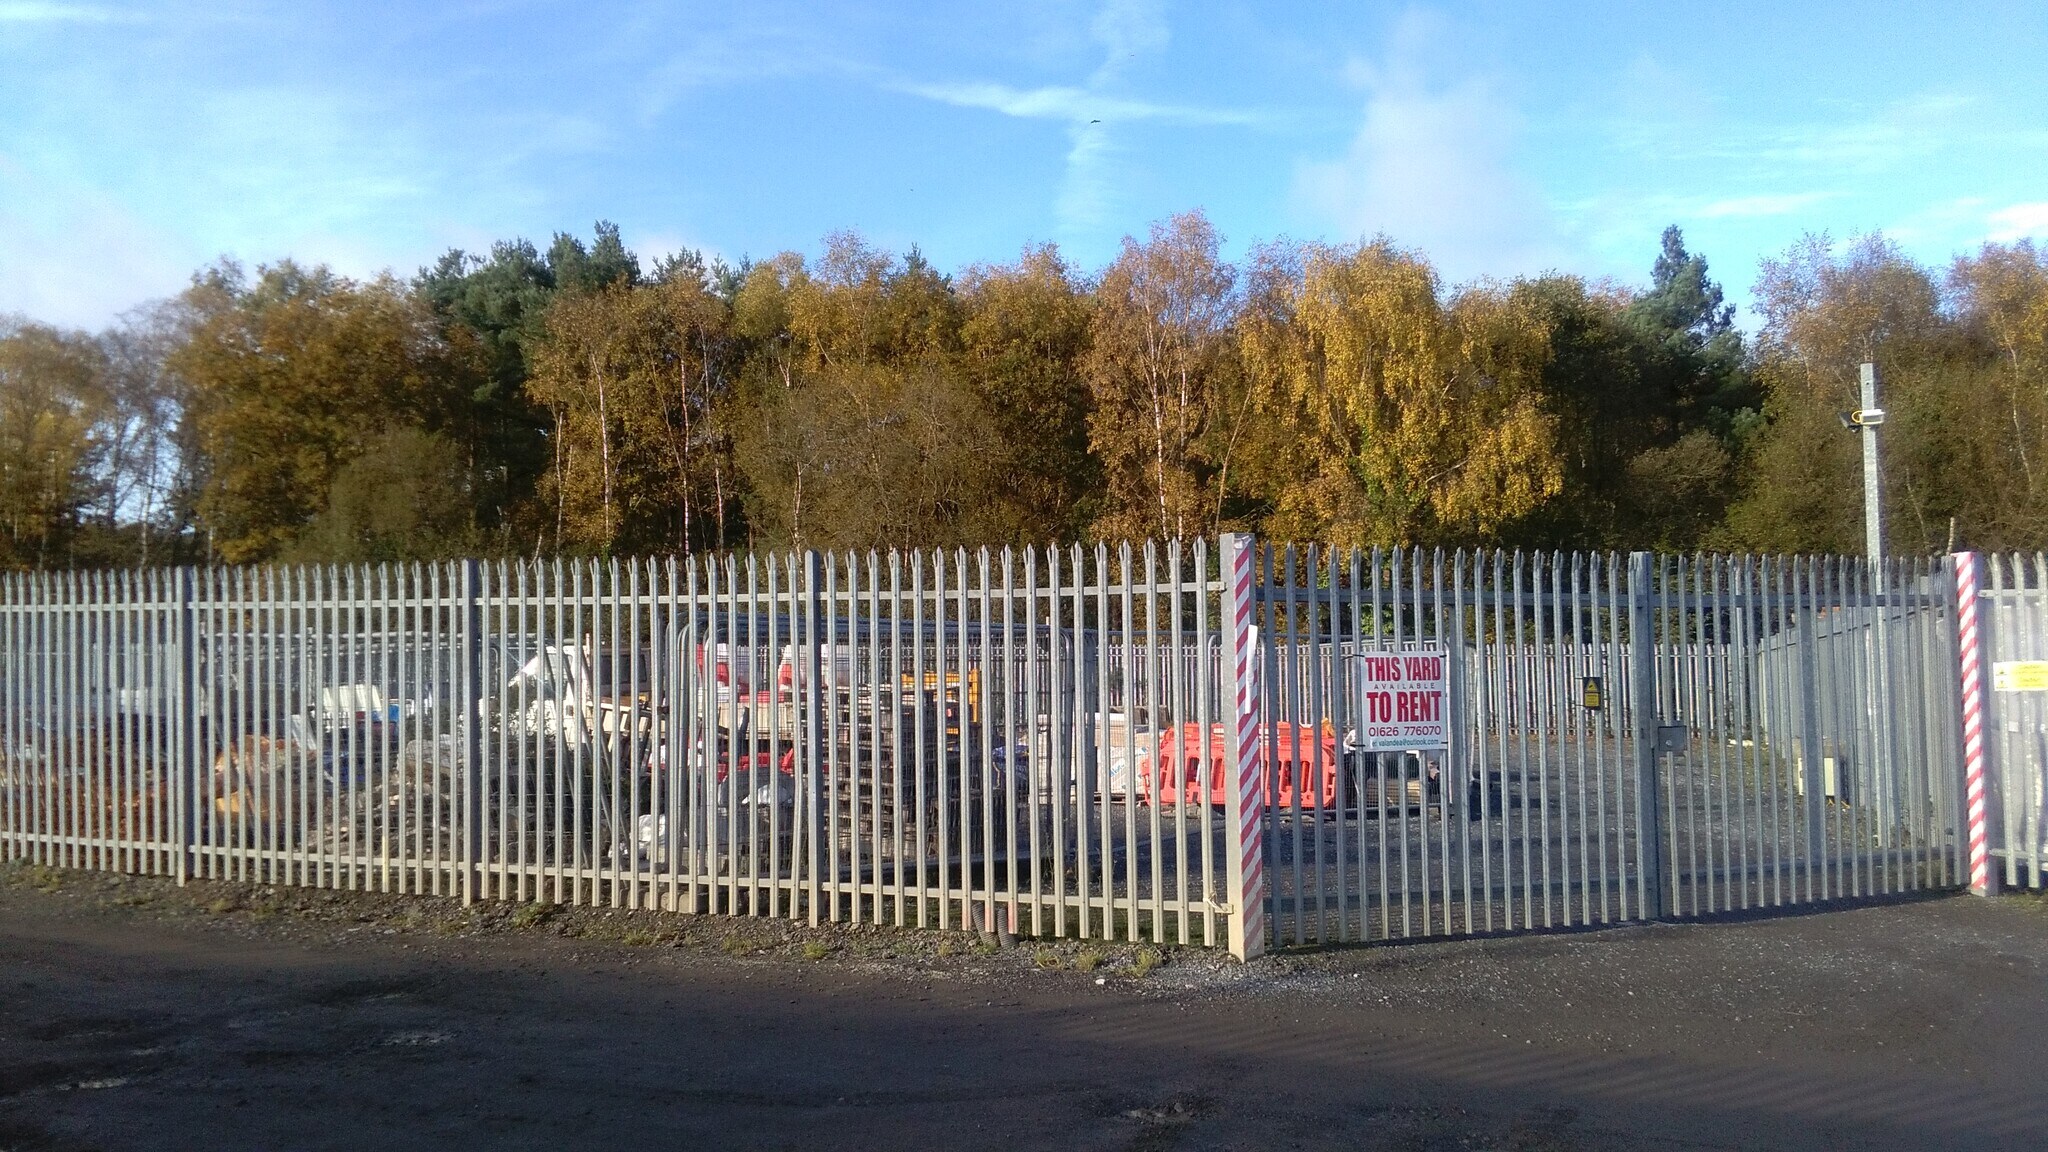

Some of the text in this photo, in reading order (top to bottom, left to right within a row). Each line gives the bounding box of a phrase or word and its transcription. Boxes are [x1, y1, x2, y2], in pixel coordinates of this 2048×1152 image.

[1365, 657, 1441, 682] THIS YARD
[1374, 682, 1435, 690] AVAILABLE
[1366, 691, 1442, 723] TO RENT
[1368, 725, 1441, 737] 01626 776070
